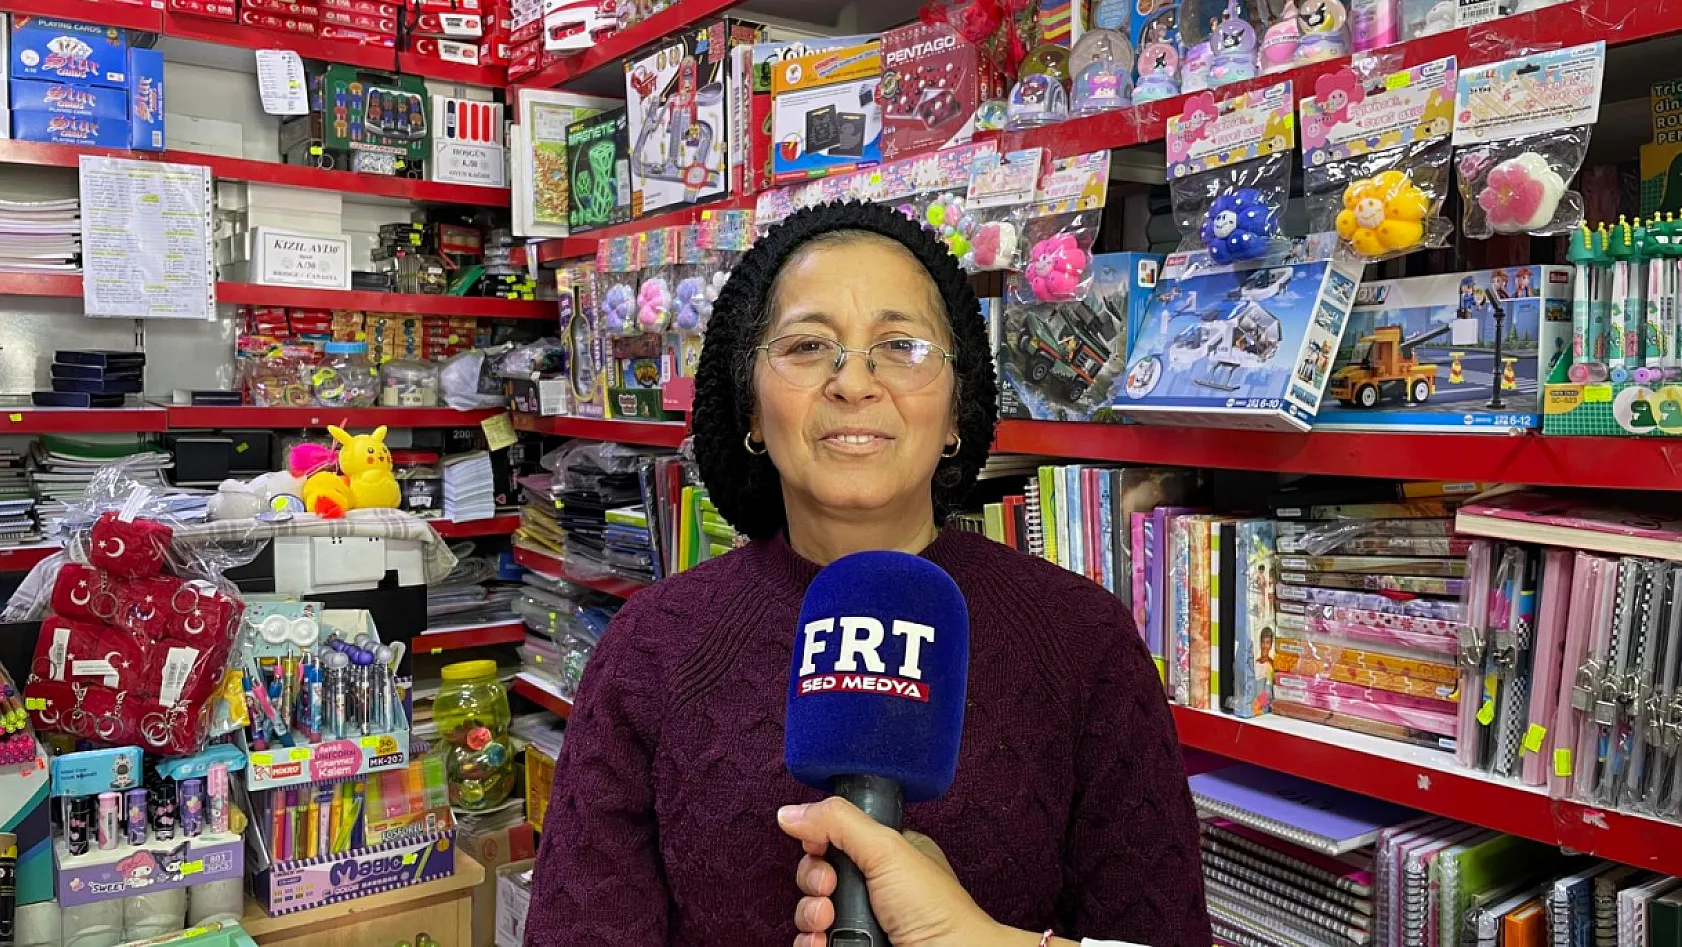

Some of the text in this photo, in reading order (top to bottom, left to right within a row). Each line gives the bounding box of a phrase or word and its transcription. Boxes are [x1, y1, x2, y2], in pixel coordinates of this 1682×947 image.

[39, 19, 72, 30] PLAYING
[886, 35, 956, 66] PENTAGO
[568, 120, 616, 145] MAGNETIC
[1510, 416, 1531, 426] 6-12
[799, 616, 935, 680] FRT
[802, 676, 921, 698] SED MEDYA
[315, 750, 356, 760] UNICORN
[319, 765, 352, 778] Kalem
[91, 882, 125, 893] SWEET
